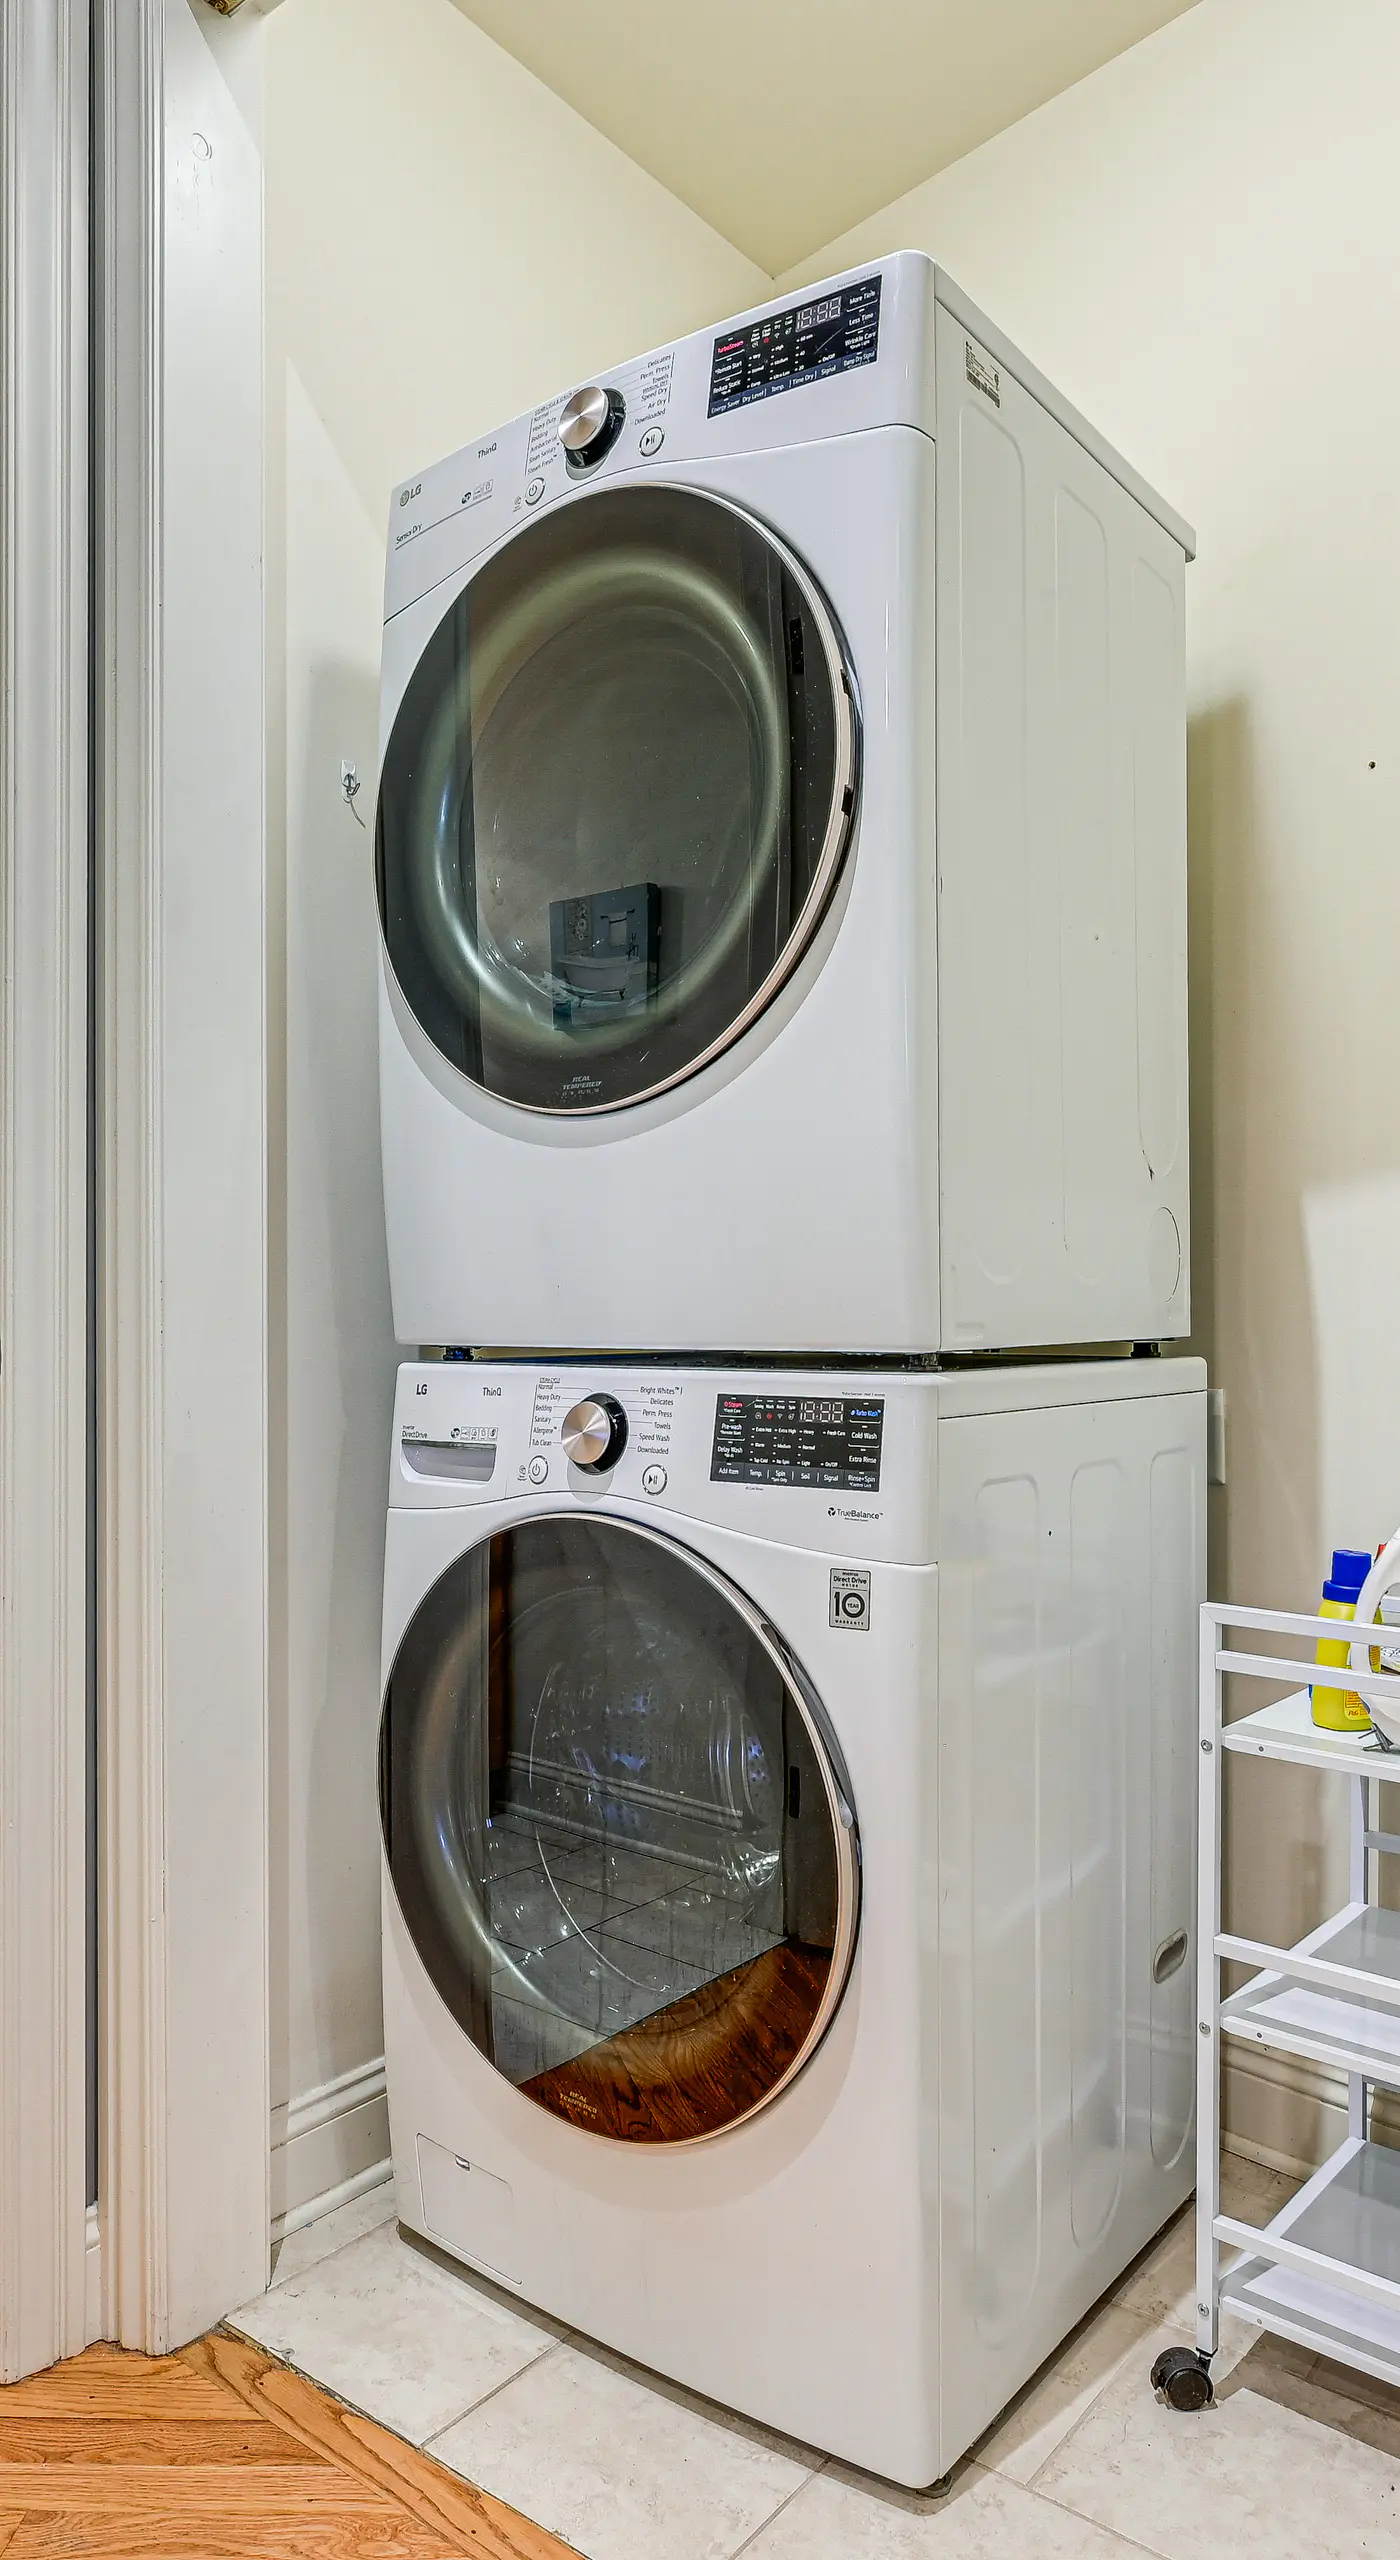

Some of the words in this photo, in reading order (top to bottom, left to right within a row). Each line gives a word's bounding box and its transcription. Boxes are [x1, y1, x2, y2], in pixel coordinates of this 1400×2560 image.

[849, 296, 862, 305] More
[849, 317, 861, 326] Less
[862, 312, 873, 322] Time
[648, 355, 671, 368] Delicates
[656, 365, 670, 374] Press
[821, 365, 836, 375] Signal
[653, 374, 669, 384] Towels
[792, 376, 804, 385] Time
[805, 373, 814, 381] Dry
[641, 390, 657, 402] Speed
[658, 387, 668, 396] Dry
[751, 391, 764, 400] Level
[657, 398, 667, 406] Dry
[711, 405, 727, 414] Energy
[634, 408, 666, 425] Downloaded
[532, 422, 545, 432] Heavy
[545, 417, 557, 426] Duty
[478, 443, 497, 459] ThinQ
[410, 484, 422, 499] LG
[396, 530, 412, 544] Sensor
[412, 524, 422, 534] Dry
[563, 1081, 602, 1090] TEMPERED
[416, 1384, 427, 1395] LG
[482, 1387, 502, 1396] ThinQ
[640, 1386, 655, 1395] Bright
[650, 1398, 673, 1406] Delicates
[658, 1410, 672, 1418] Press
[534, 1416, 551, 1424] Sanitary
[654, 1422, 671, 1430] Towels
[639, 1433, 655, 1441] Speed
[656, 1434, 670, 1442] Wash
[637, 1445, 669, 1454] Downloaded
[749, 1469, 762, 1477] Temp.
[823, 1474, 838, 1482] Signal
[834, 1591, 865, 1618] 10
